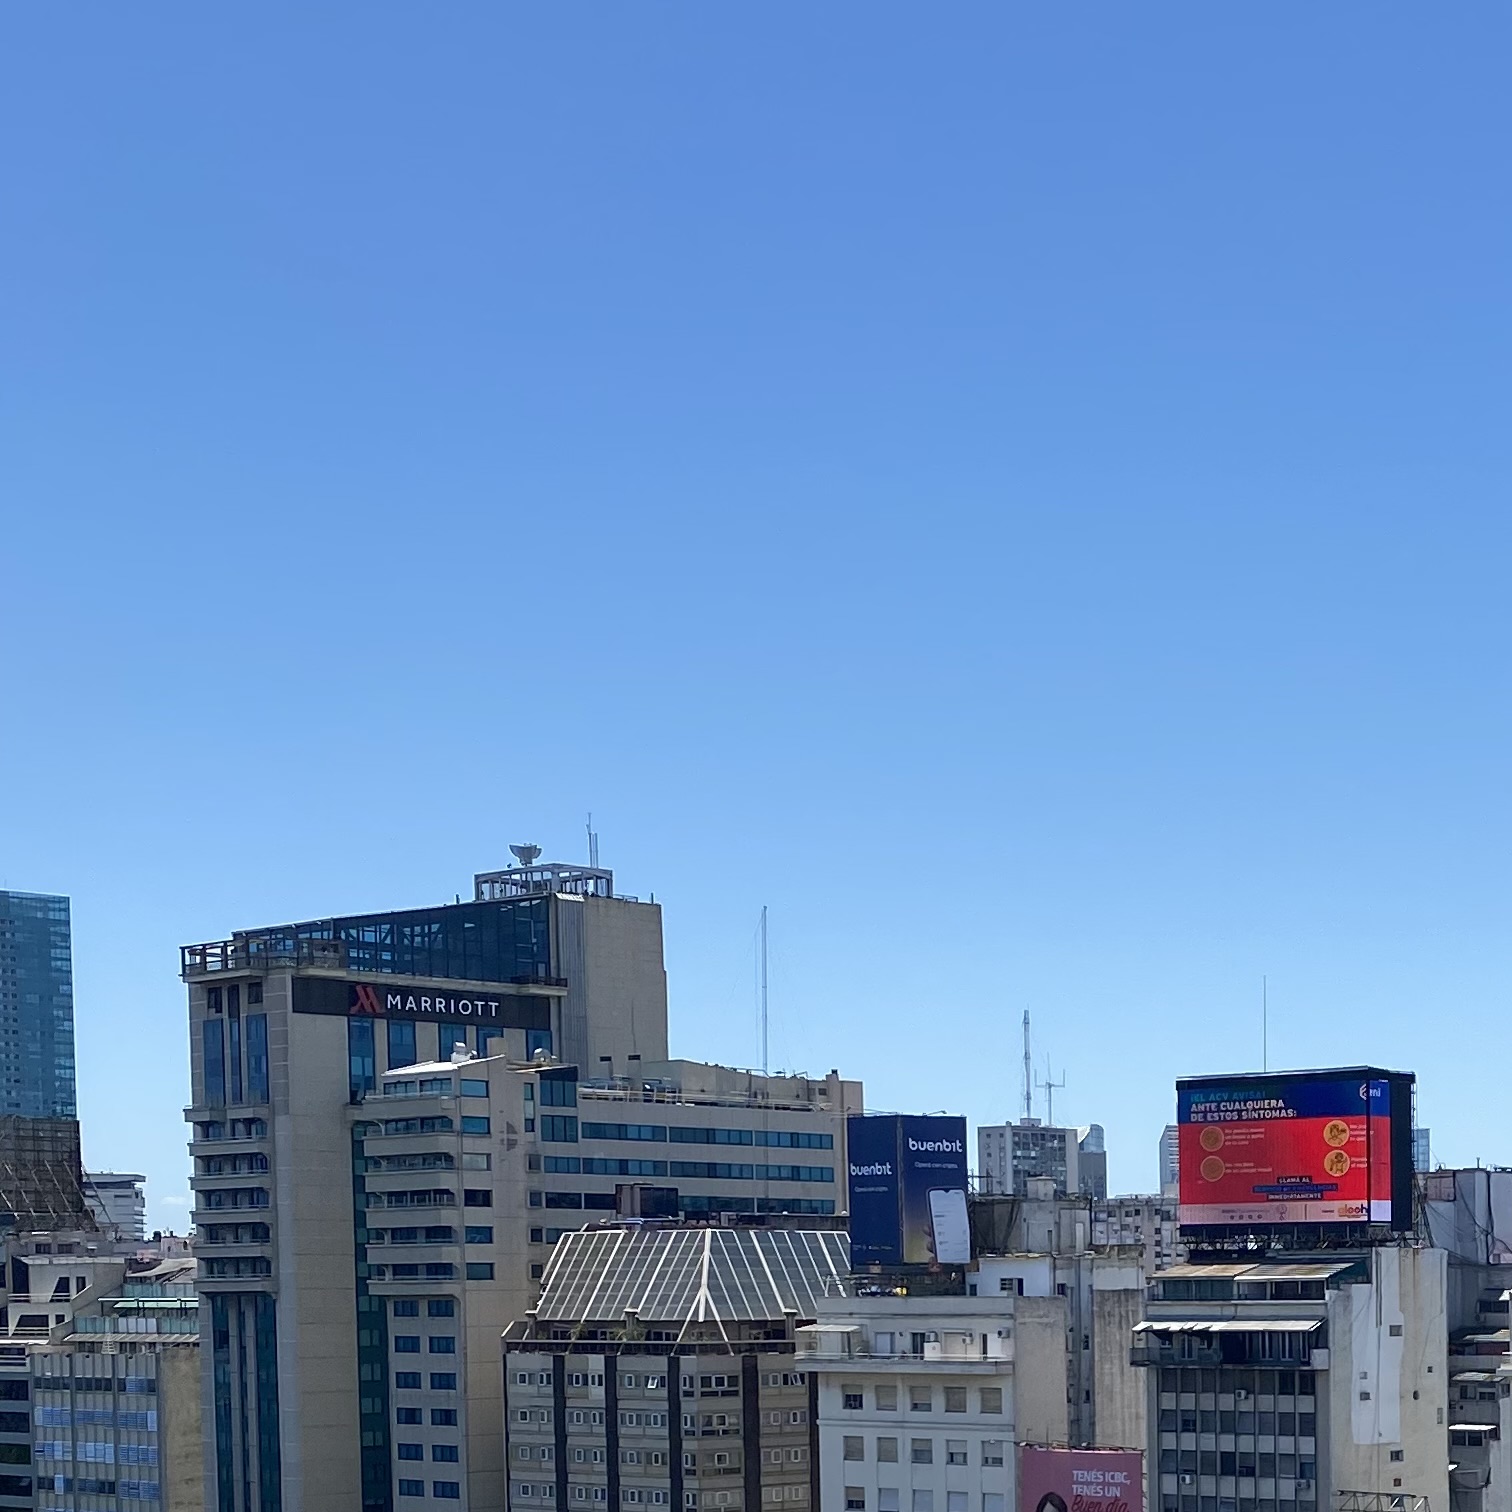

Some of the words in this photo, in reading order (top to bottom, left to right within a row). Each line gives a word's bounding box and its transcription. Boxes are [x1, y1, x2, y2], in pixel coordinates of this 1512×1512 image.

[387, 994, 500, 1017] MARRIOTT
[1190, 1103, 1218, 1112] ANTE
[1220, 1099, 1285, 1111] CUALQUIERA
[1190, 1112, 1205, 1122] DE
[1207, 1111, 1238, 1121] ESTOS
[908, 1138, 963, 1152] buenbit
[850, 1161, 892, 1176] buenbit
[1072, 1469, 1104, 1482] TENÉS
[1105, 1472, 1131, 1486] ICBC,
[1072, 1484, 1103, 1497] TENÉS
[1105, 1486, 1120, 1498] UN
